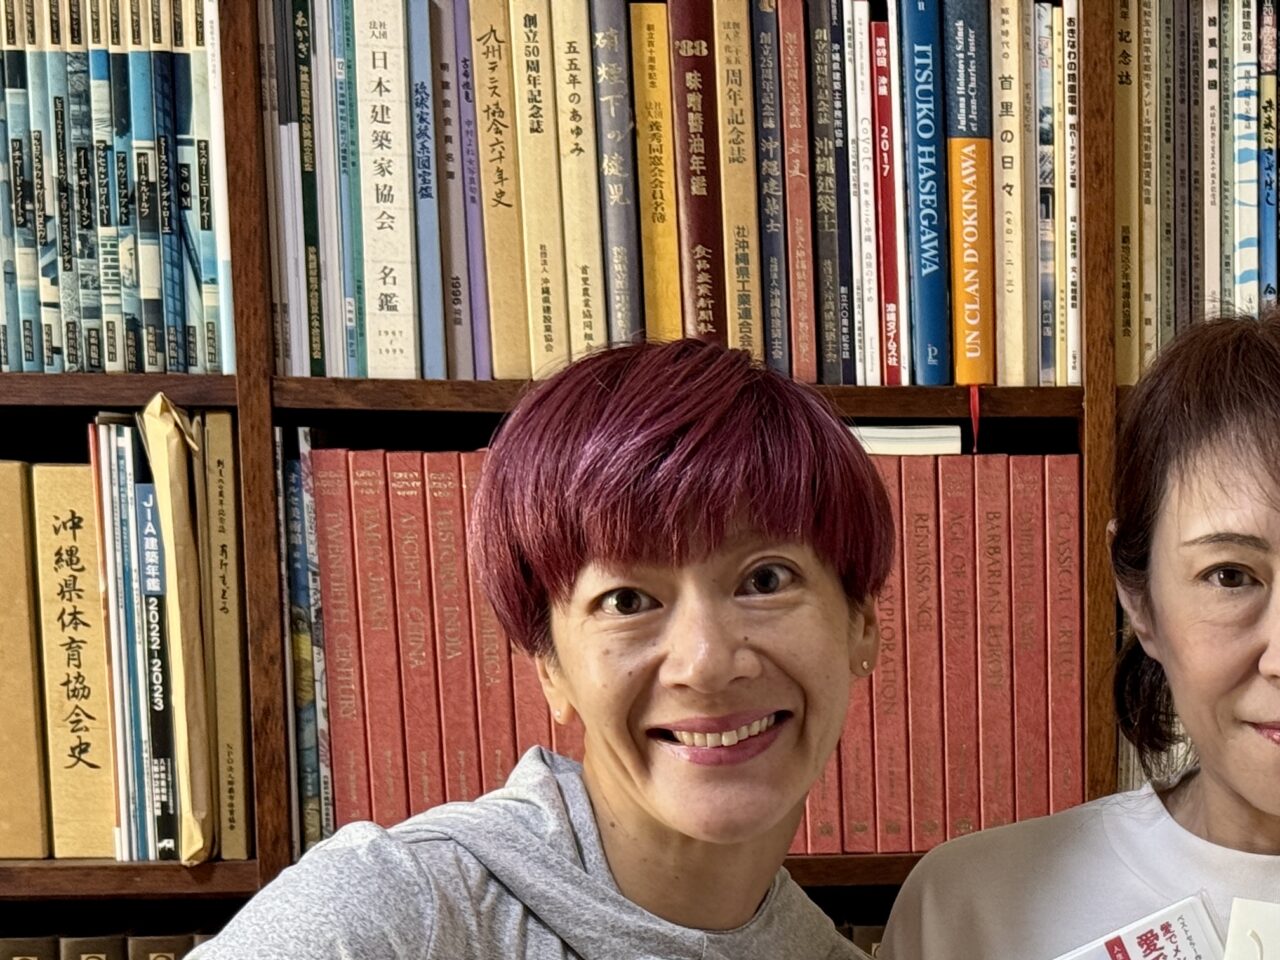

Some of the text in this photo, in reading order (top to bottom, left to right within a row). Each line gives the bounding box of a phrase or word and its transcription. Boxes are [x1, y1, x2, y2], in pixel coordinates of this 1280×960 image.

[523, 13, 544, 134] 創立50周年記念誌
[564, 40, 585, 157] 五五年のあゆみ
[371, 51, 399, 312] 日本建築家協会 名鑑
[881, 126, 890, 176] 2017
[914, 43, 940, 277] ITSUKO HASEGAWA
[998, 75, 1015, 197] 首里の日々
[964, 265, 981, 327] CLAN
[964, 331, 981, 359] UN
[143, 494, 164, 711] JIA建築年鑑 2022-2023
[912, 511, 932, 633] RENAISSANCE
[985, 511, 1004, 616] BARBARIAN
[52, 509, 102, 770] 沖縄県体育協会史
[442, 604, 463, 660] INDIA
